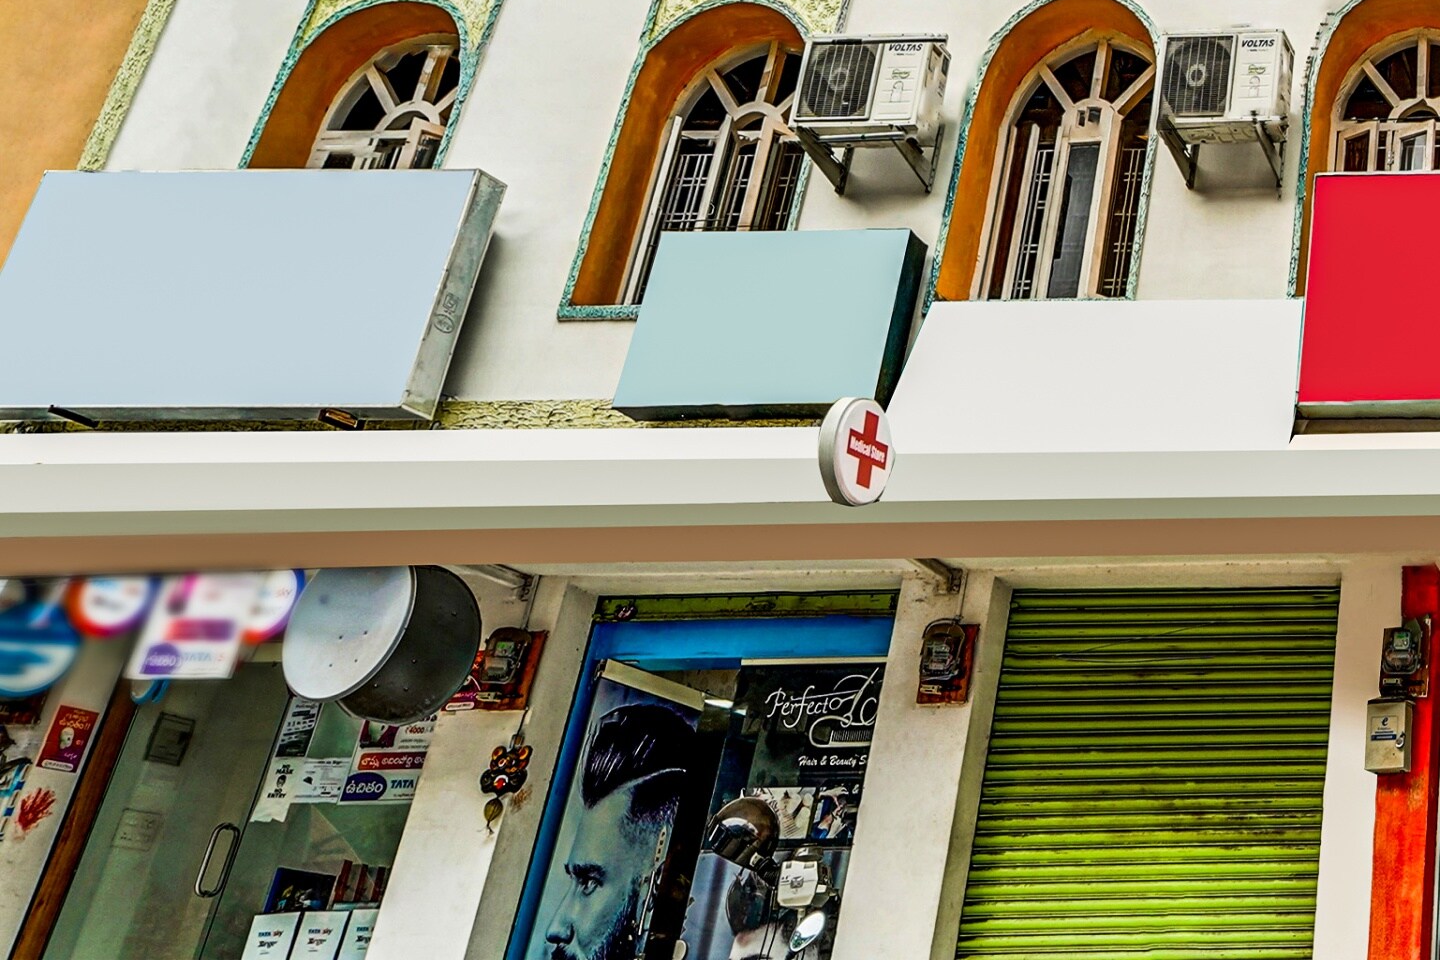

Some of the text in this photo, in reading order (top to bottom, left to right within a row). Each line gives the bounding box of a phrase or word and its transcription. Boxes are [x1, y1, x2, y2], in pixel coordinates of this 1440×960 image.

[889, 43, 923, 52] VOLTAS
[1241, 39, 1275, 47] VOLTAS
[849, 435, 886, 463] Medical Store
[798, 755, 818, 767] Hair
[820, 755, 828, 766] &
[829, 754, 857, 768] Beauty
[344, 780, 384, 794] ఉచితం
[390, 779, 414, 789] TATA
